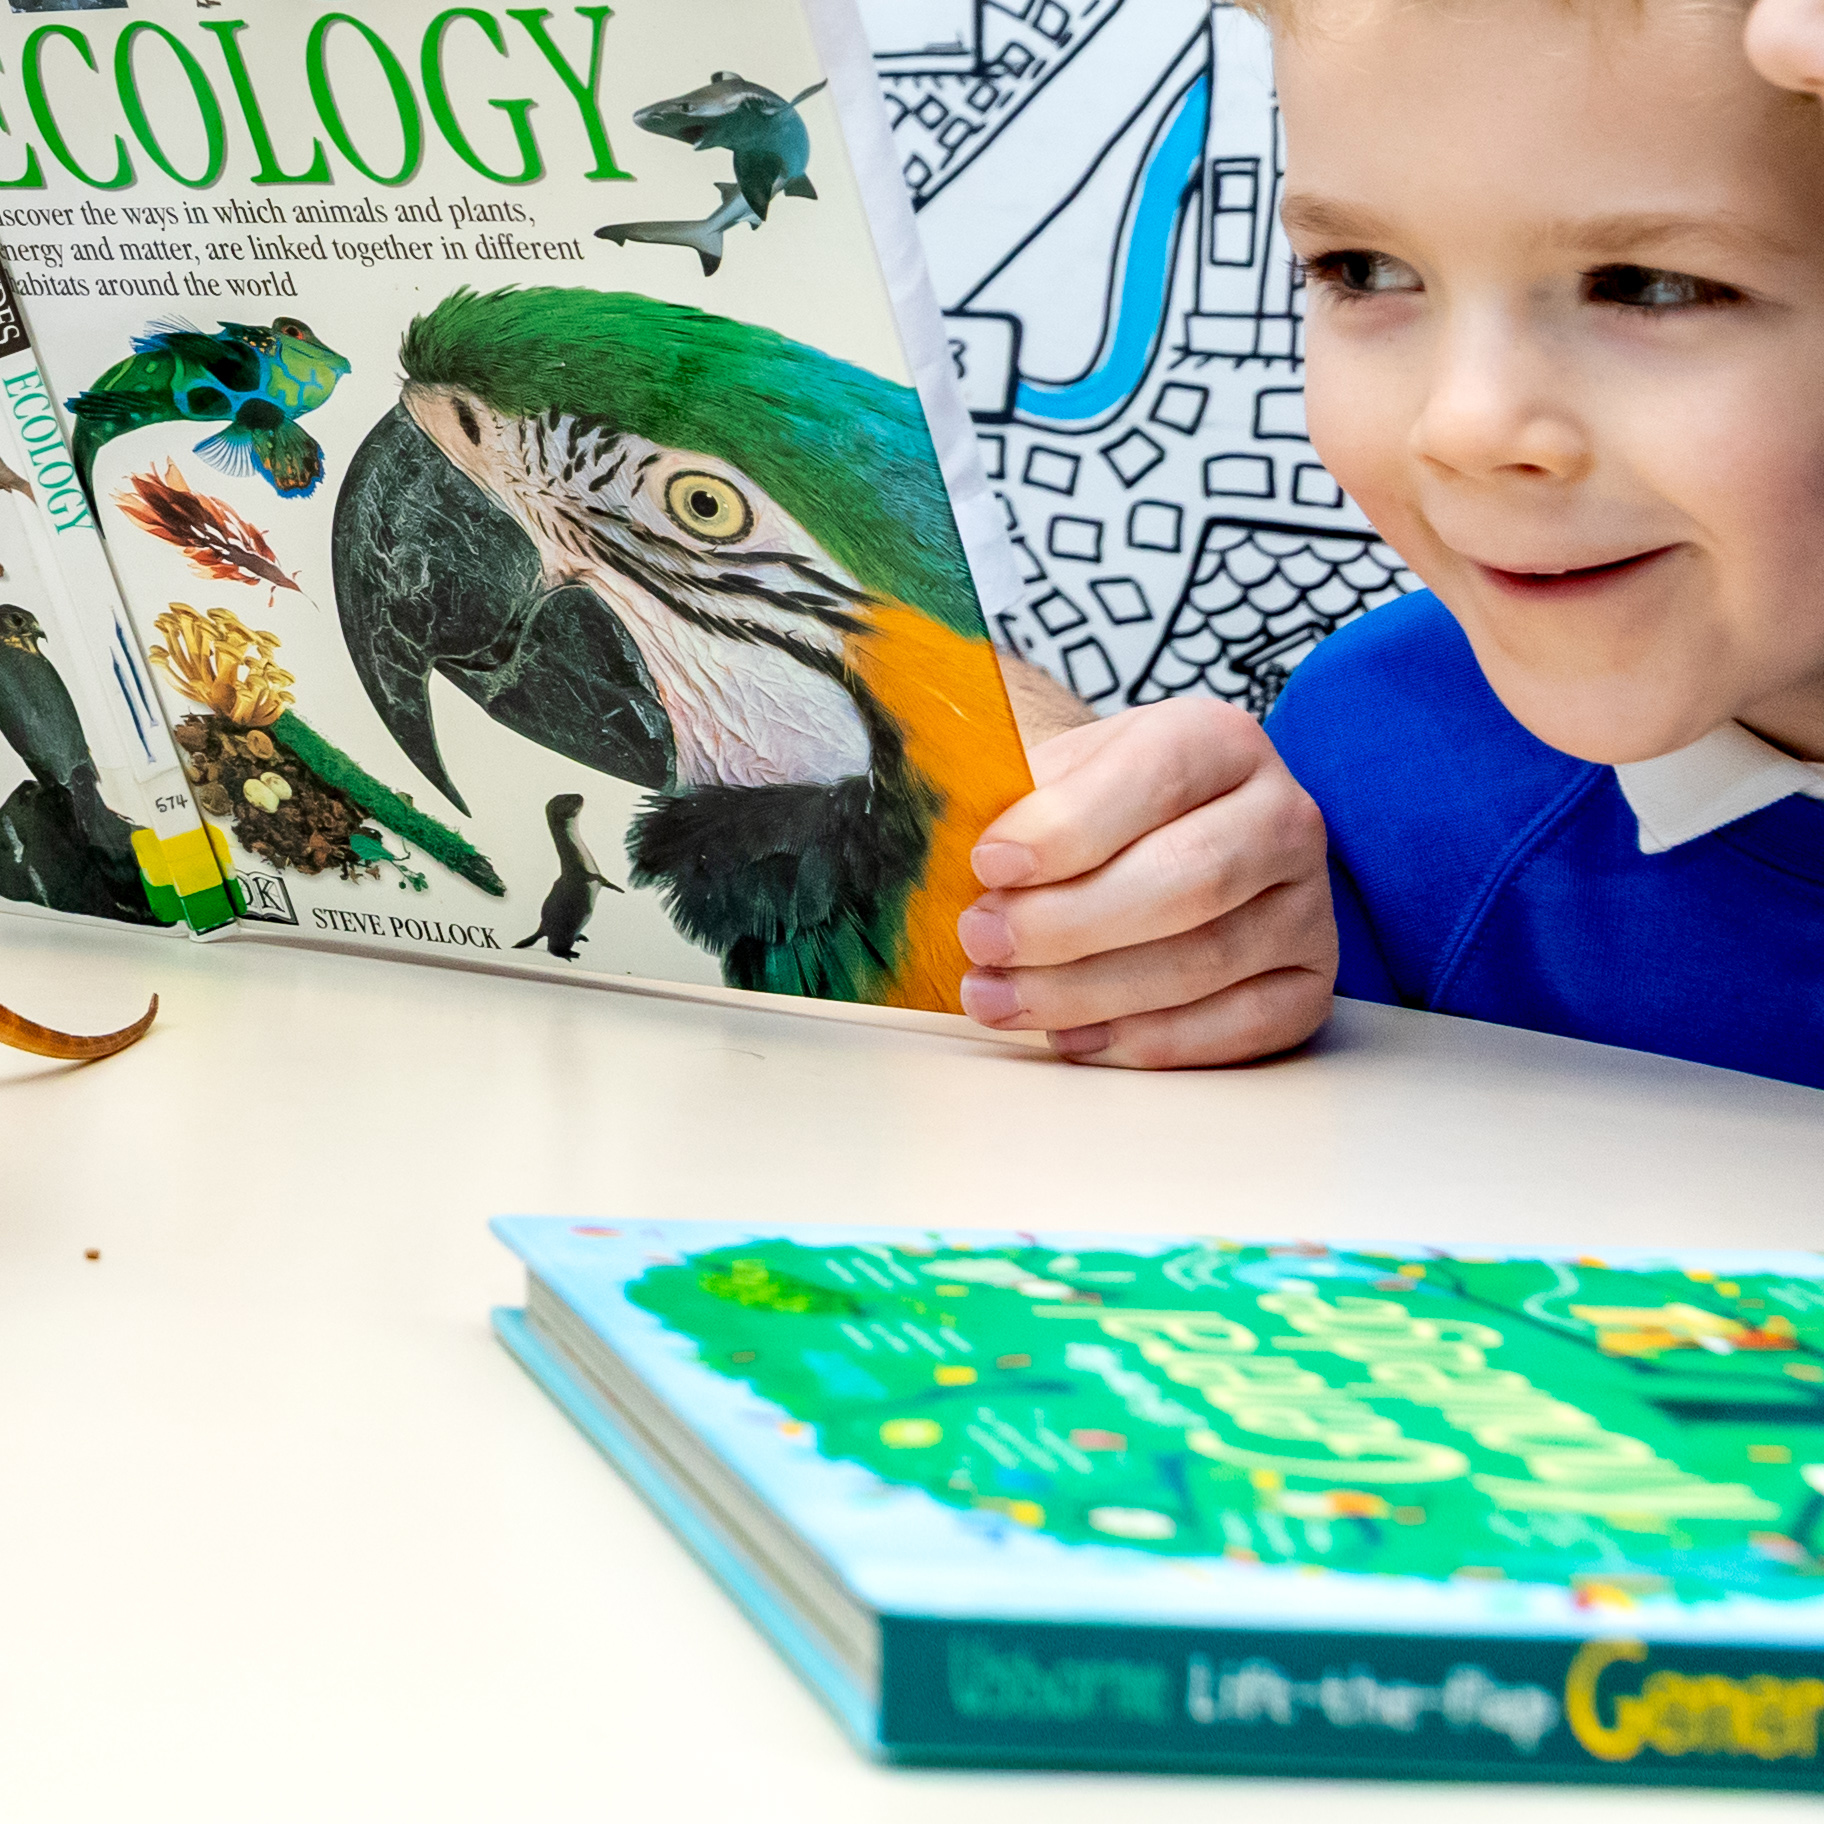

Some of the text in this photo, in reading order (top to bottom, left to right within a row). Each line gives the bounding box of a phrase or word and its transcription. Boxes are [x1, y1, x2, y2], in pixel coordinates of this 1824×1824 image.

[79, 200, 119, 226] the
[120, 206, 179, 232] ways
[183, 206, 210, 225] in
[211, 197, 288, 224] which
[291, 196, 389, 224] animals
[394, 195, 444, 223] and
[447, 195, 536, 230] plants,
[70, 235, 116, 261] and
[118, 239, 201, 266] matter,
[204, 242, 246, 261] are
[246, 233, 329, 261] linked
[331, 233, 434, 268] together
[441, 241, 469, 260] in
[474, 232, 586, 261] different
[94, 270, 181, 297] around
[182, 270, 223, 297] the
[224, 270, 299, 297] world
[0, 370, 93, 536] ECOLOGY
[155, 794, 189, 813] 574
[312, 907, 502, 950] STEVE POLLOCK
